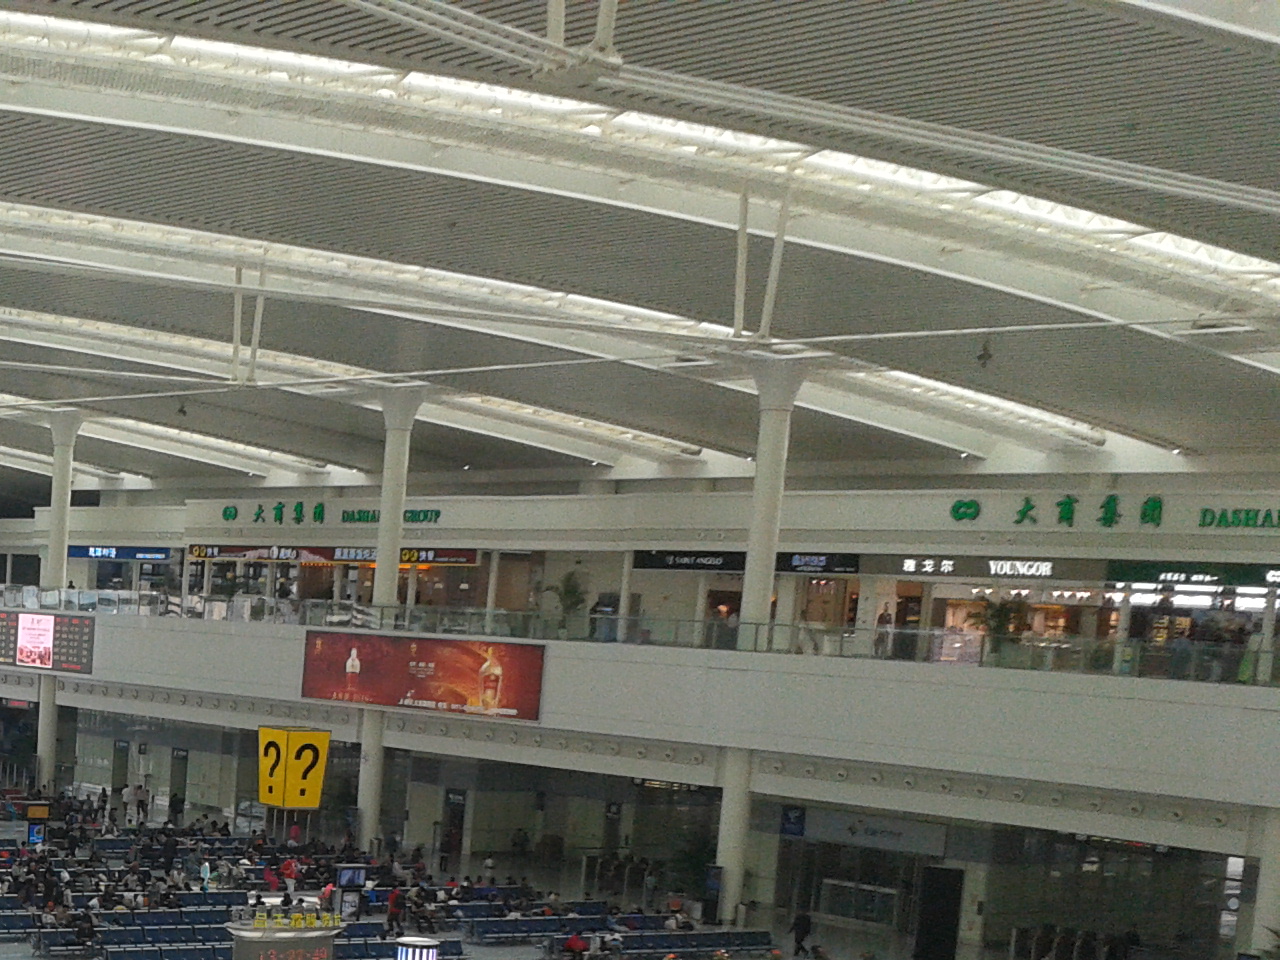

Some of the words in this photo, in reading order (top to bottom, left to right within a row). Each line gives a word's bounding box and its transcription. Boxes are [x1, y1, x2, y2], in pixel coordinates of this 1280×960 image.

[341, 509, 380, 523] DASHA
[403, 509, 441, 523] GROUP
[1013, 494, 1163, 527] 大商集团
[1199, 508, 1280, 528] DASHA
[902, 559, 955, 573] 雅戈尔
[988, 560, 1053, 576] YOUNGOR
[264, 741, 281, 794] ?
[295, 743, 320, 796] ?
